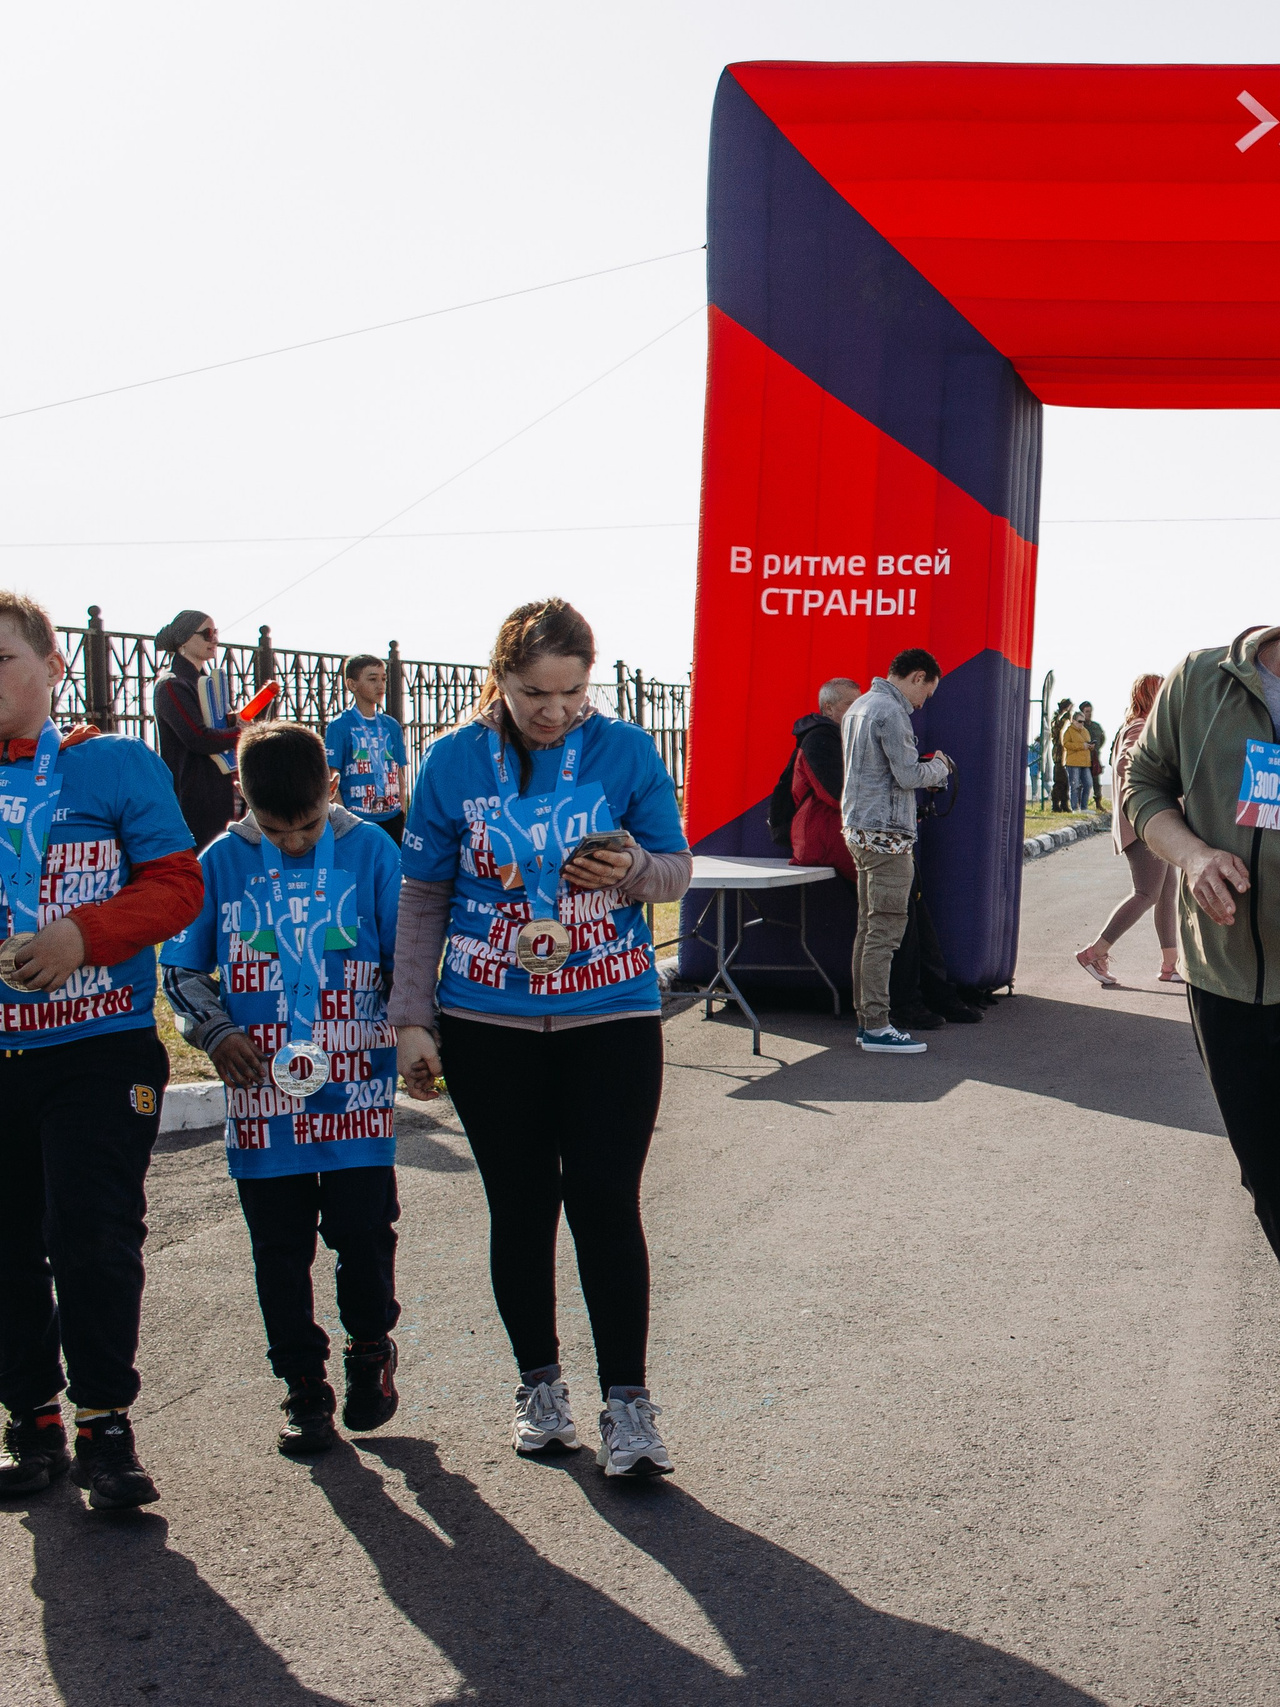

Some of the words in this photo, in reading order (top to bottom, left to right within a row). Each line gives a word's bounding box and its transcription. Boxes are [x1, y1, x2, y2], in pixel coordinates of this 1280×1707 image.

[730, 546, 753, 574] В
[763, 553, 866, 579] ритме
[877, 548, 951, 576] всей
[760, 587, 918, 617] СТРАНЫ!
[38, 753, 51, 775] ПСБ
[47, 838, 122, 875] #ЦЕЛЬ
[529, 942, 652, 996] #ЕДИНСТВО
[0, 984, 134, 1033] ЕДИНСТВО
[345, 1076, 394, 1113] 2024
